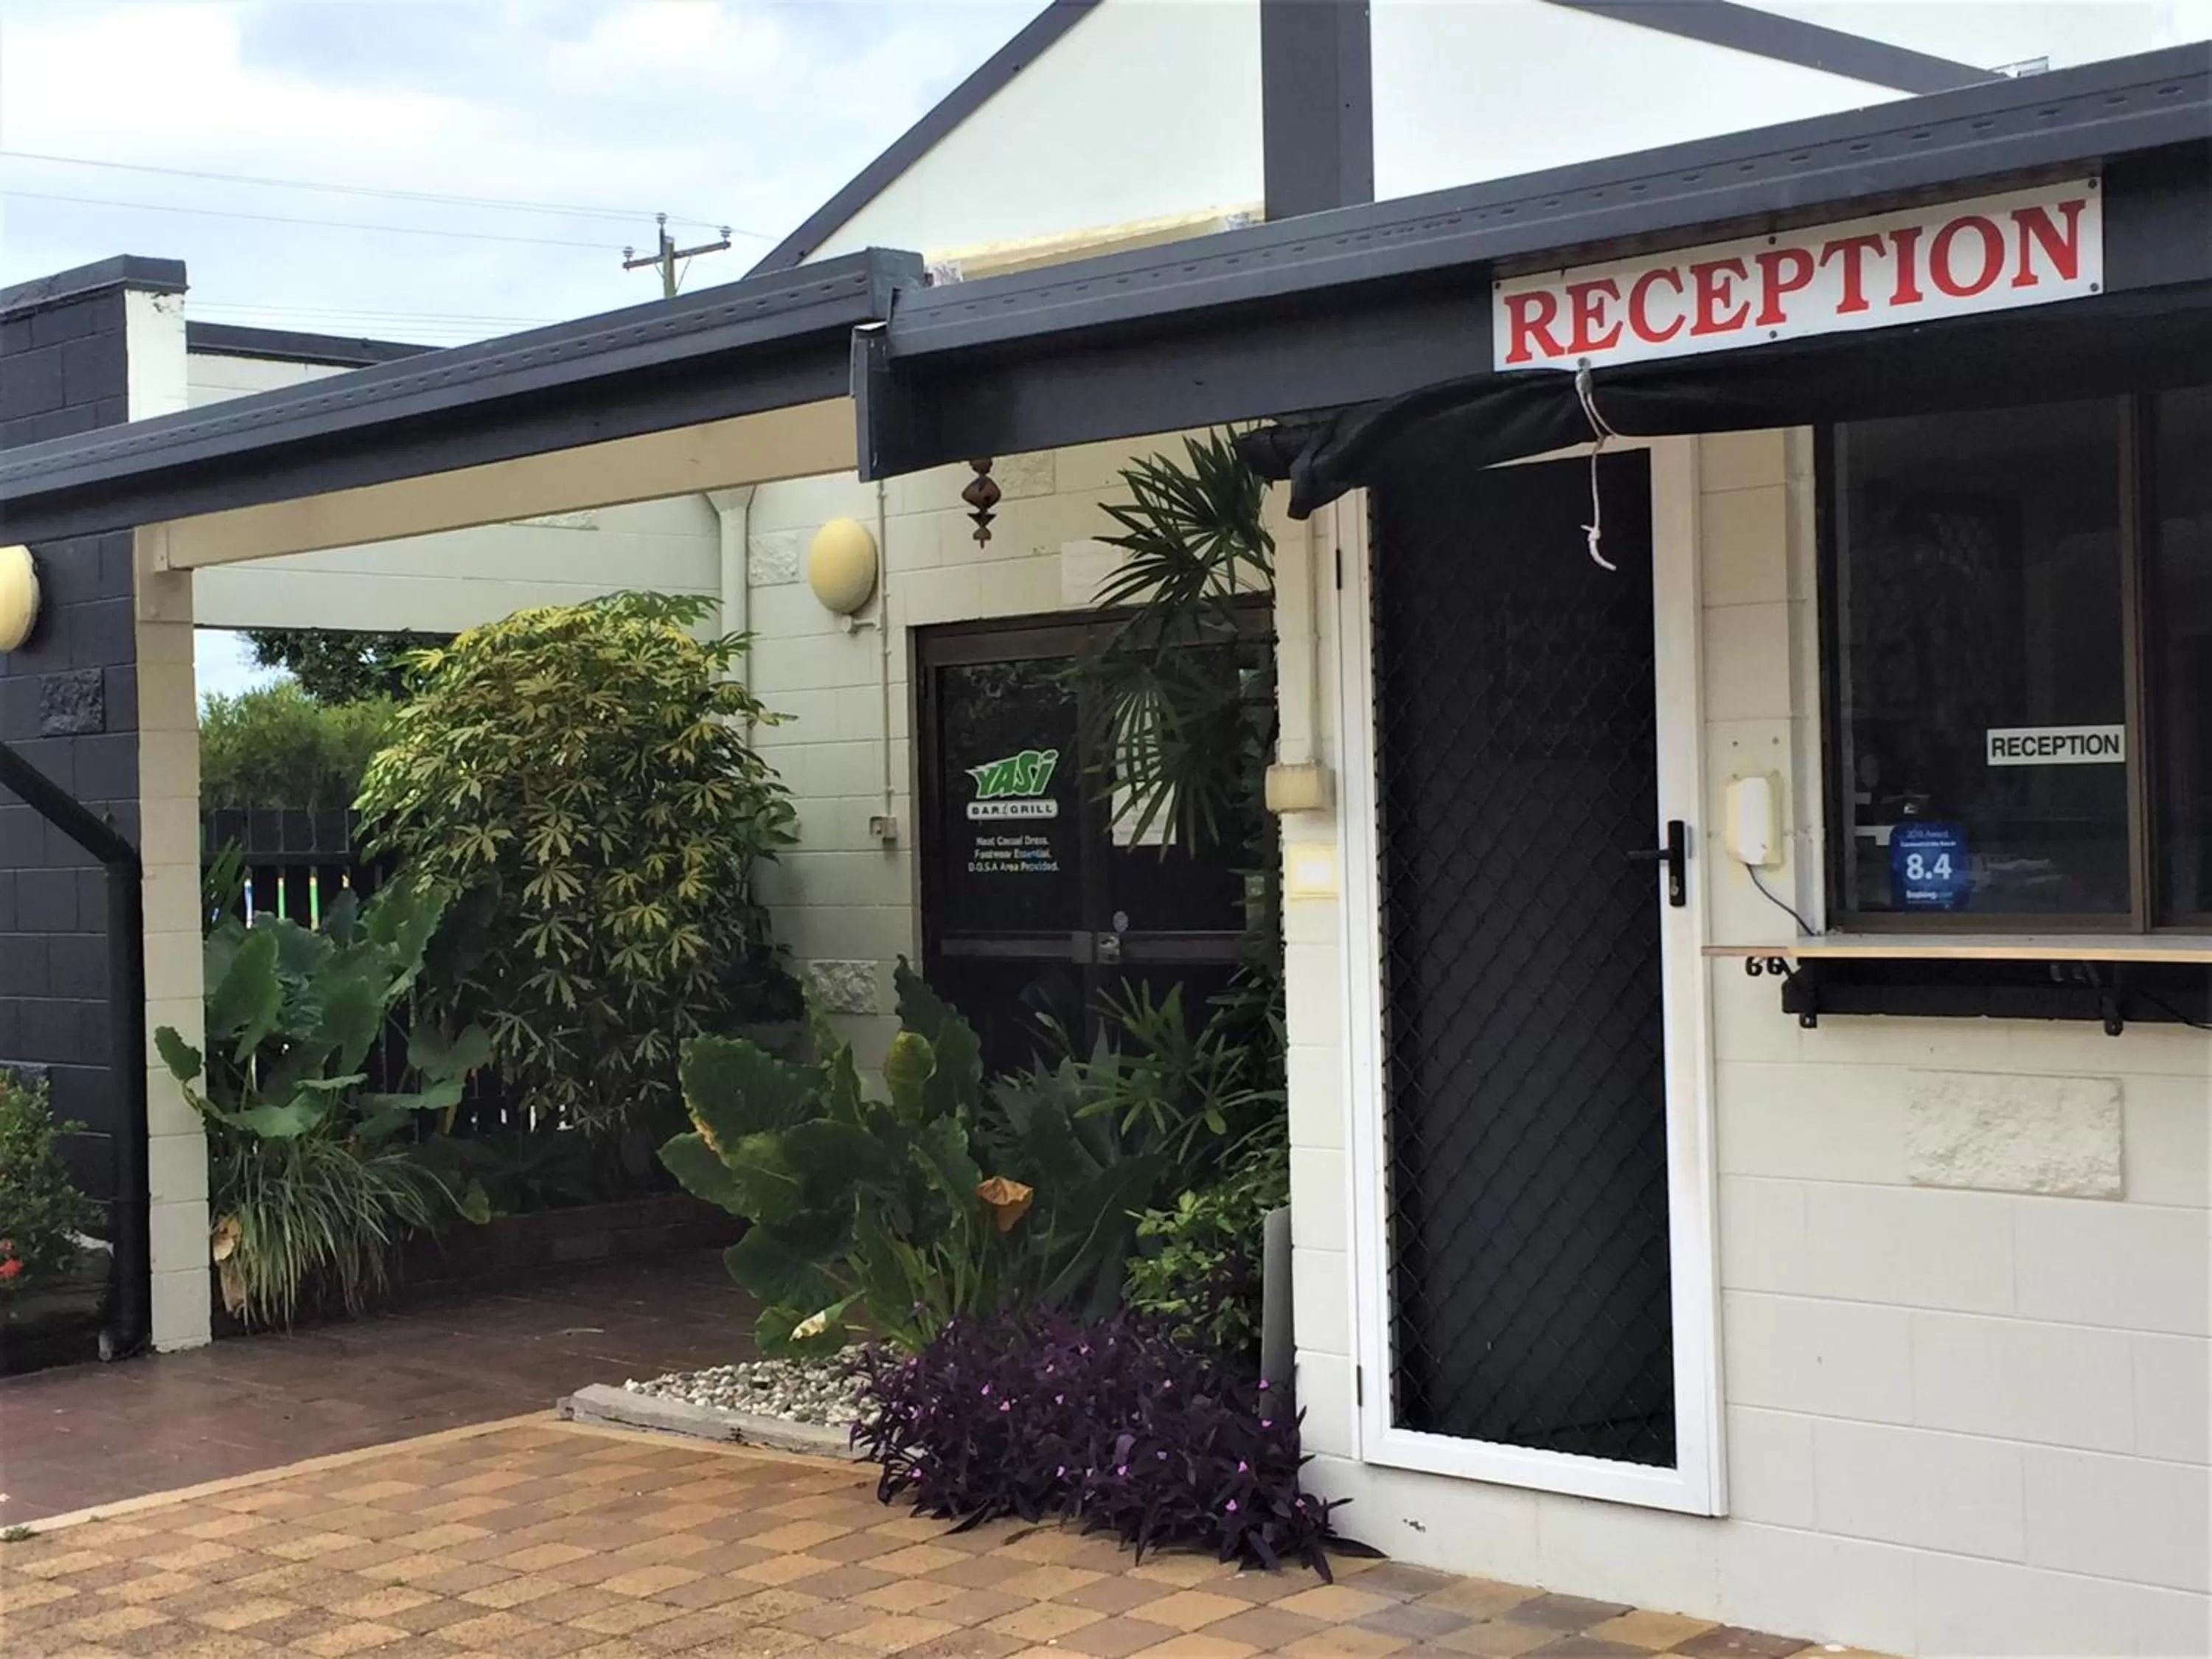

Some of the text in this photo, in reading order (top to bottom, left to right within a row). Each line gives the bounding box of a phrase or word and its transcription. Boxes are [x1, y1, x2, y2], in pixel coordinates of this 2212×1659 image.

[1504, 199, 2086, 364] RECEPTION
[1992, 734, 2120, 757] RECEPTION
[1009, 804, 1052, 814] GRILL
[1906, 852, 1952, 880] 8.4
